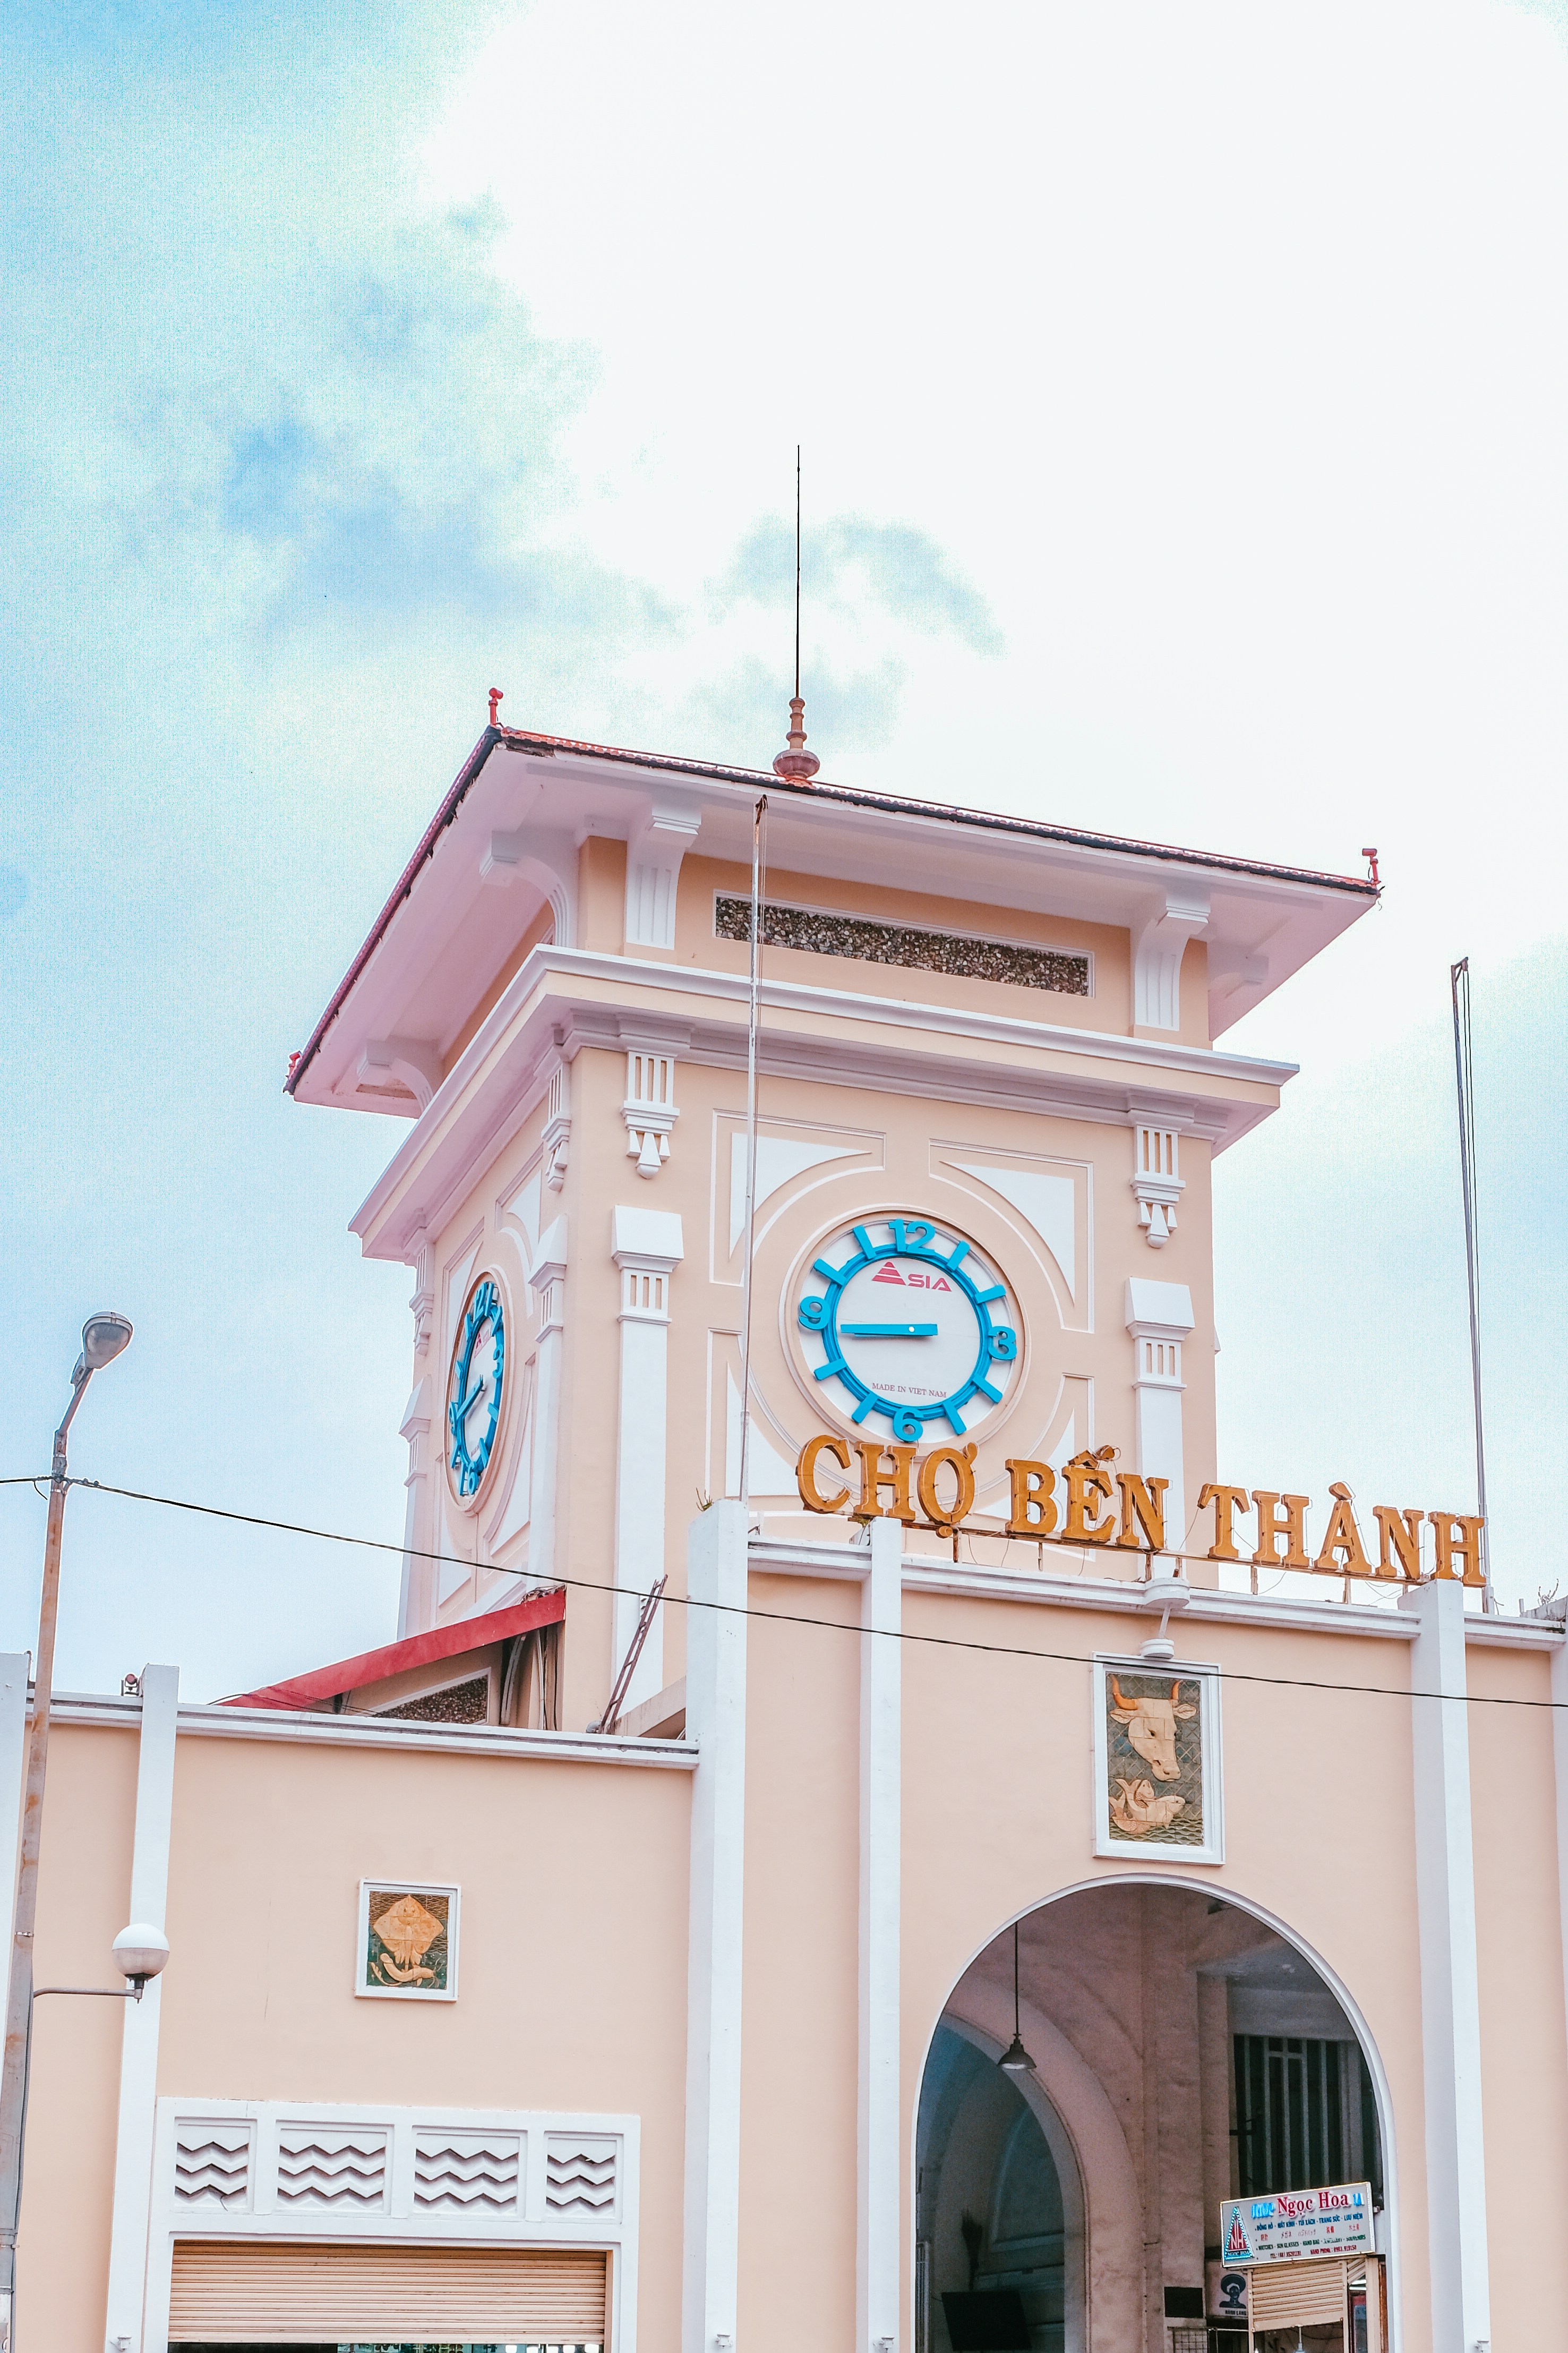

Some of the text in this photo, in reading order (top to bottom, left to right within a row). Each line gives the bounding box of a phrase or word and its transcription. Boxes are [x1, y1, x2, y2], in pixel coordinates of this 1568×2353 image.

[888, 1218, 936, 1256] 12
[871, 1261, 953, 1292] ASIA
[798, 1296, 832, 1330] 9
[988, 1326, 1017, 1360] 3
[493, 1344, 503, 1379] 3
[872, 1383, 895, 1393] MADE
[908, 1387, 927, 1396] VIET
[928, 1389, 947, 1399] NAM
[893, 1406, 923, 1443] 6
[798, 1434, 1487, 1588] CHỢ BẾN THÀNH
[1277, 2197, 1313, 2217] Ngọc
[1318, 2192, 1349, 2209] Hoa
